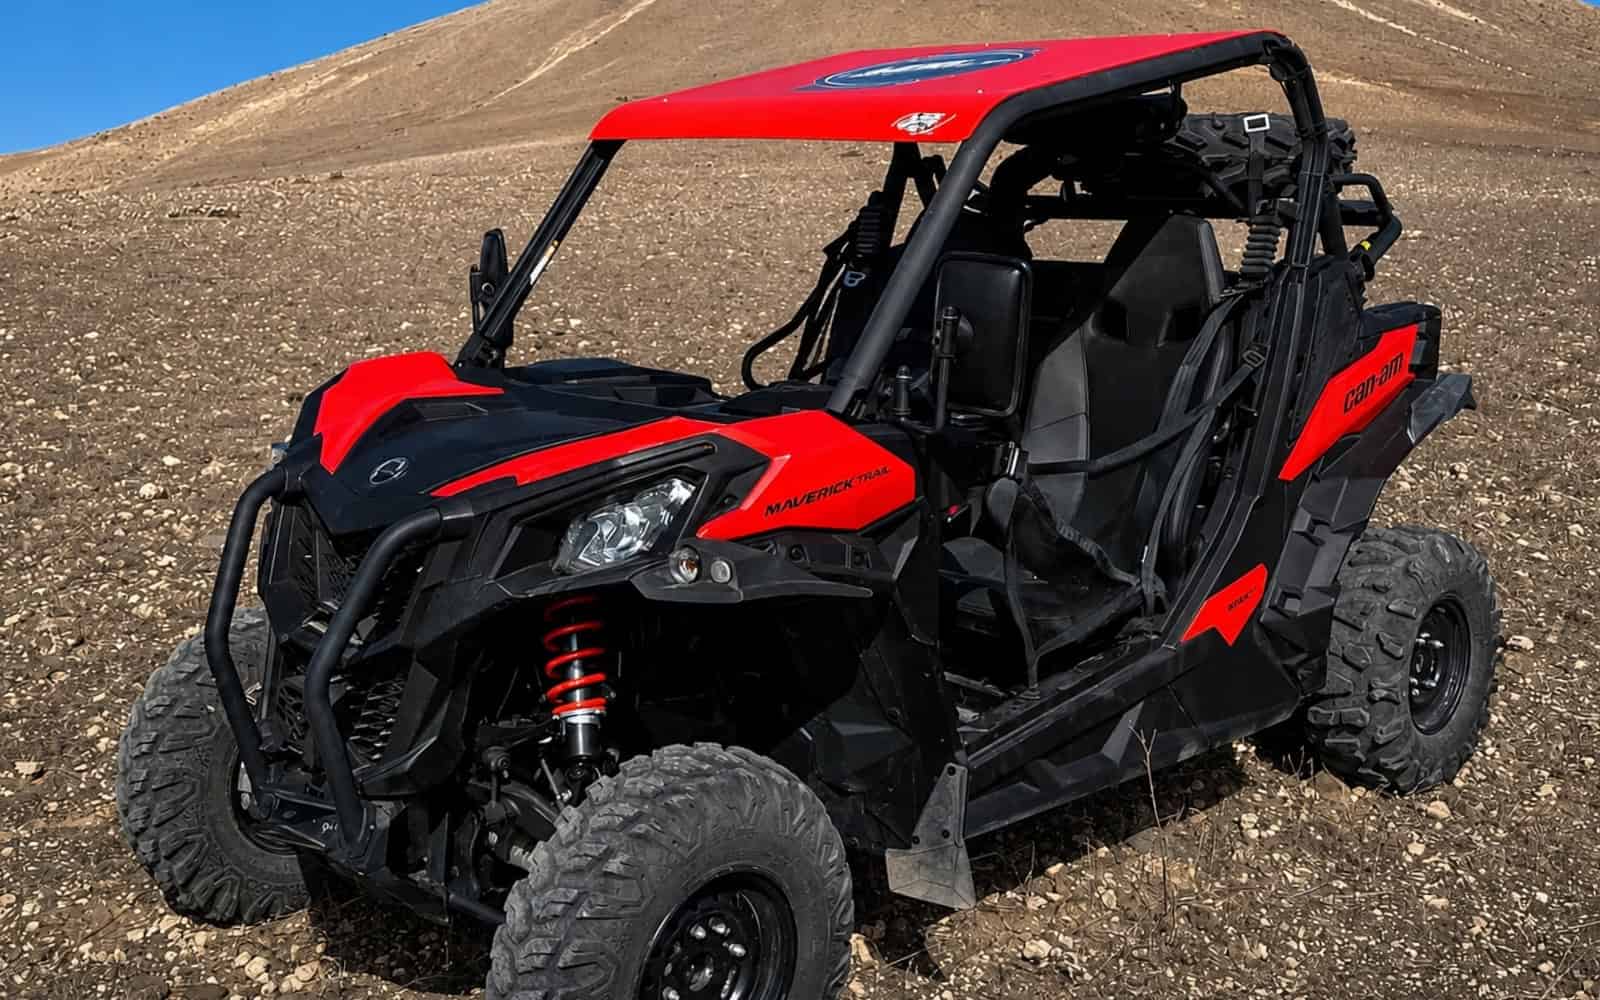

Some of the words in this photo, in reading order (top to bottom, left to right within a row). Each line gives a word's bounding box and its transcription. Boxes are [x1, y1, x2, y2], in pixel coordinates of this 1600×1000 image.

[1343, 352, 1404, 415] can-am
[765, 477, 853, 517] MAVERICK
[857, 465, 890, 484] TRAIL
